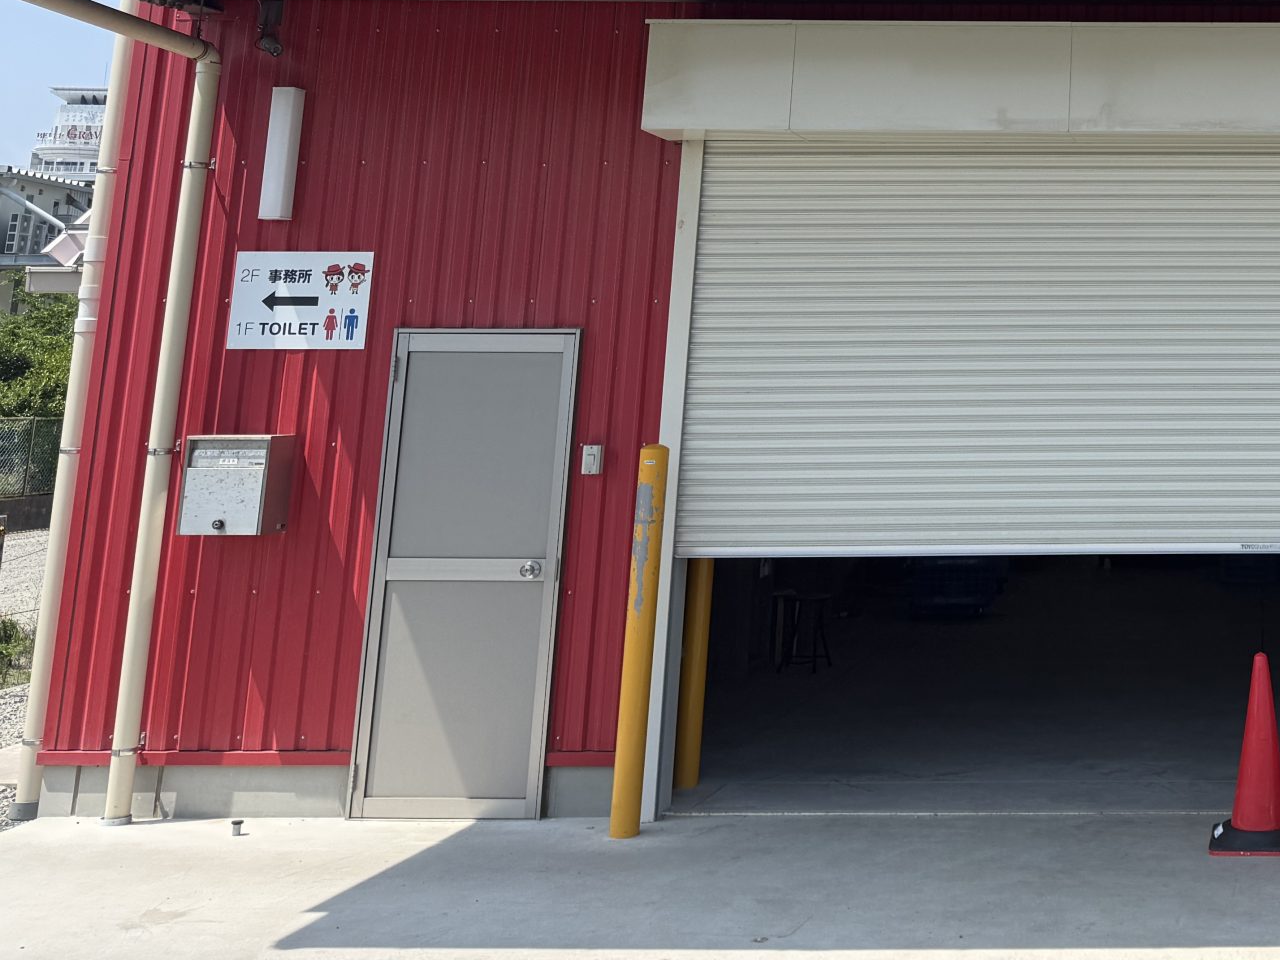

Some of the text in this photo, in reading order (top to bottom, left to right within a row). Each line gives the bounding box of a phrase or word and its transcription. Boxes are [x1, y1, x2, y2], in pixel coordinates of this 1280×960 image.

[240, 268, 313, 284] 2F 事務所
[236, 321, 319, 336] 1F TOILET
